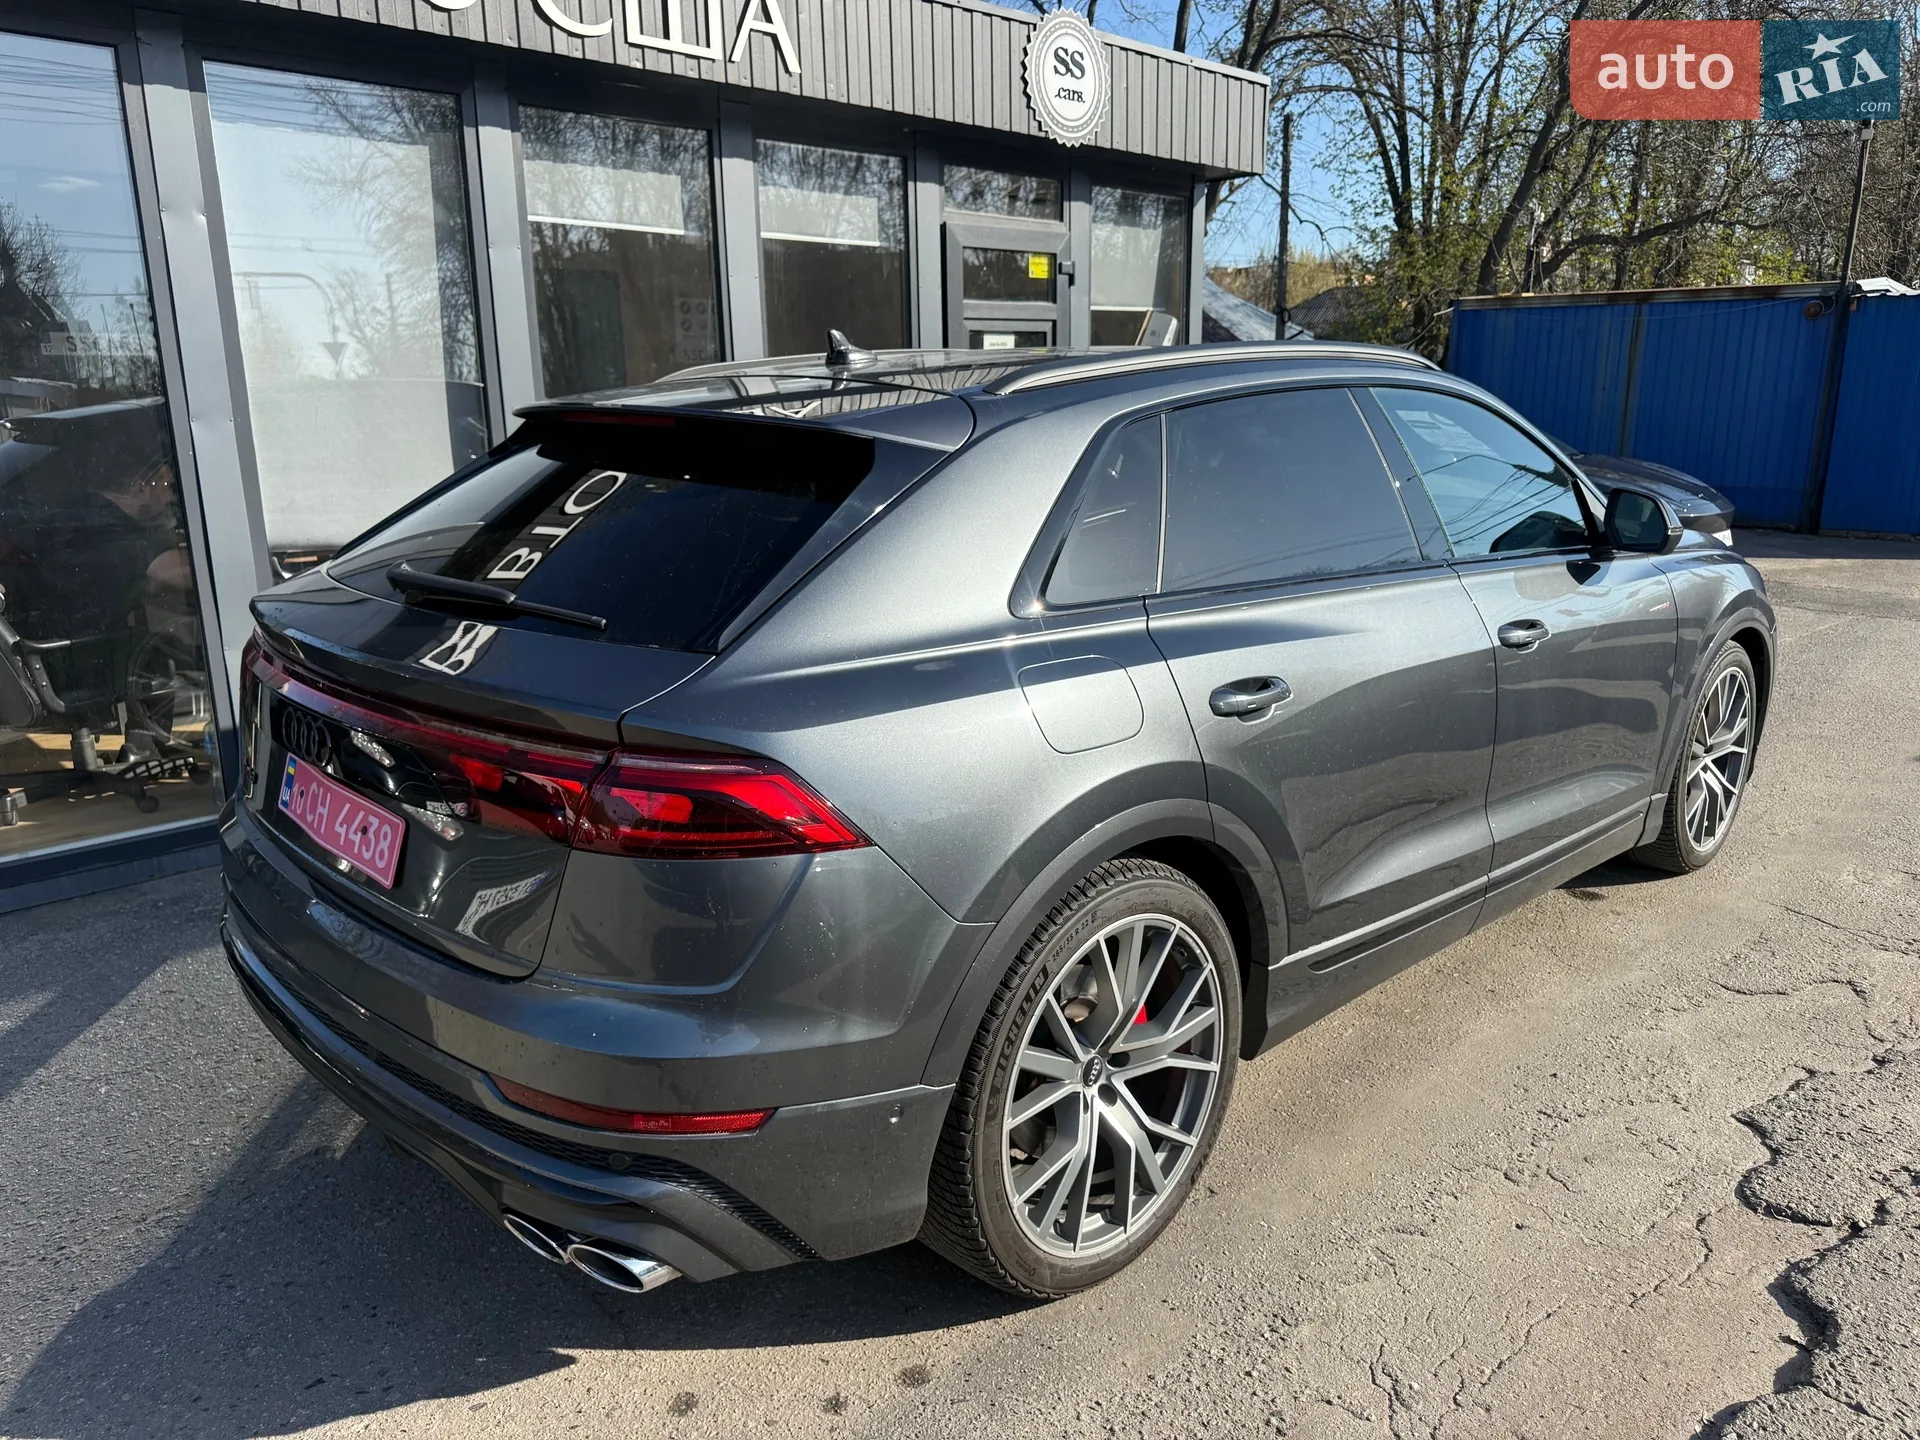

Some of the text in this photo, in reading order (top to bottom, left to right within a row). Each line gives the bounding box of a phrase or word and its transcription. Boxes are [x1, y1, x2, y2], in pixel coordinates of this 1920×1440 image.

[1053, 46, 1086, 80] SS
[282, 785, 291, 804] UA
[291, 781, 392, 869] 10 CH 4438
[993, 972, 1047, 1087] MICHELIN
